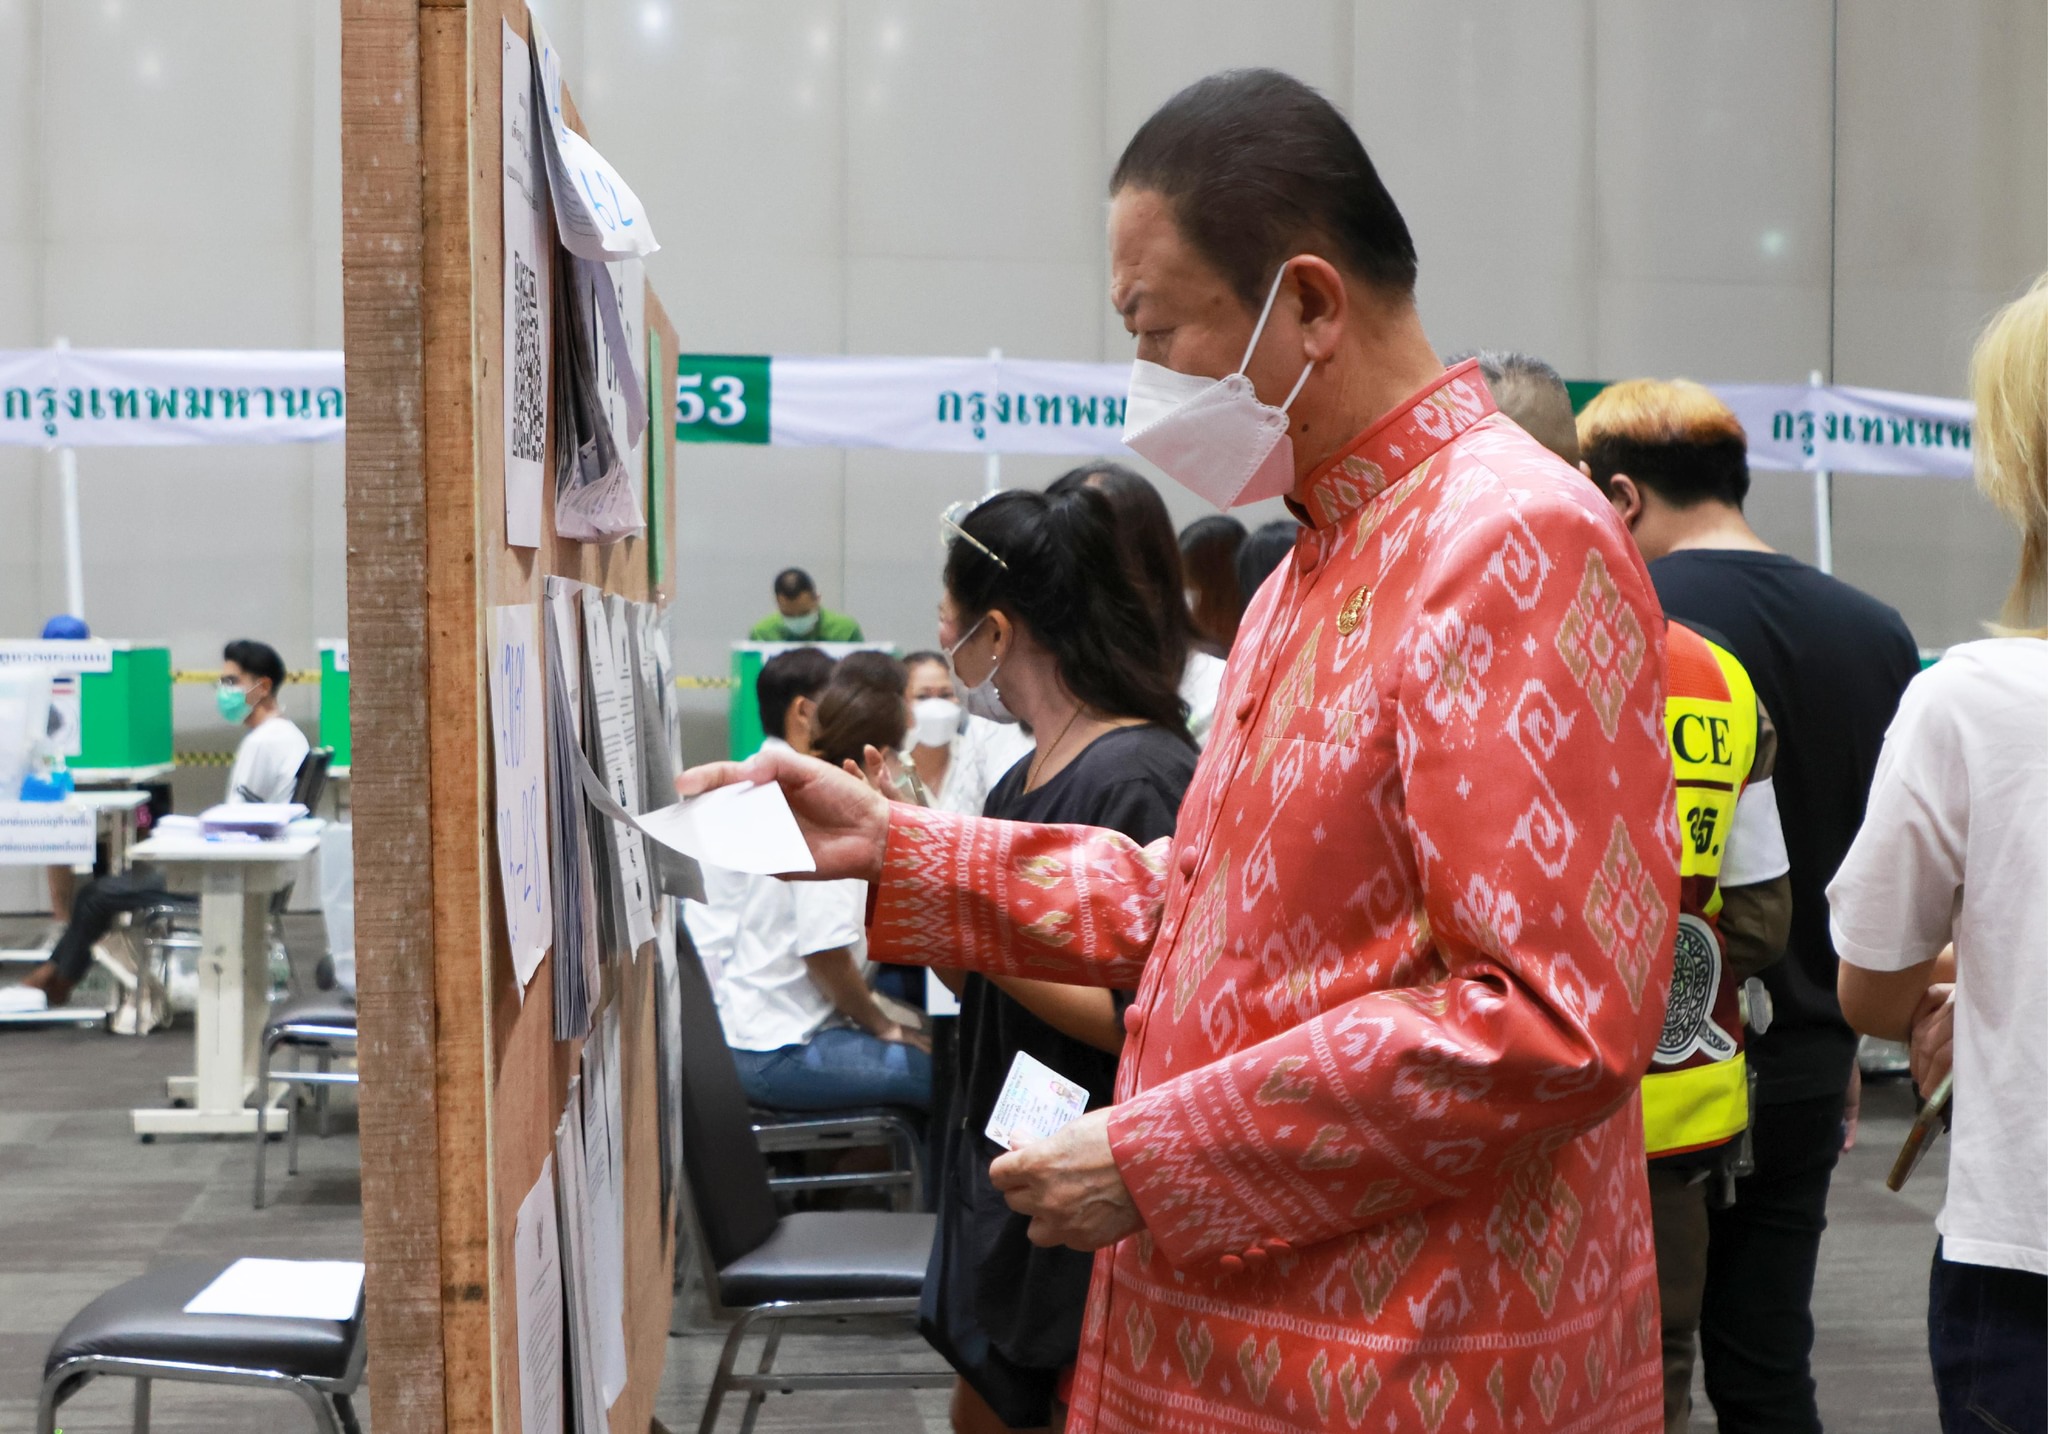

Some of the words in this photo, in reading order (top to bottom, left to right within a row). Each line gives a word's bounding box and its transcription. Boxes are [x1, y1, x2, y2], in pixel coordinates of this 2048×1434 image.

[5, 386, 343, 437] กรุงเทพมหานค
[676, 372, 747, 426] 53
